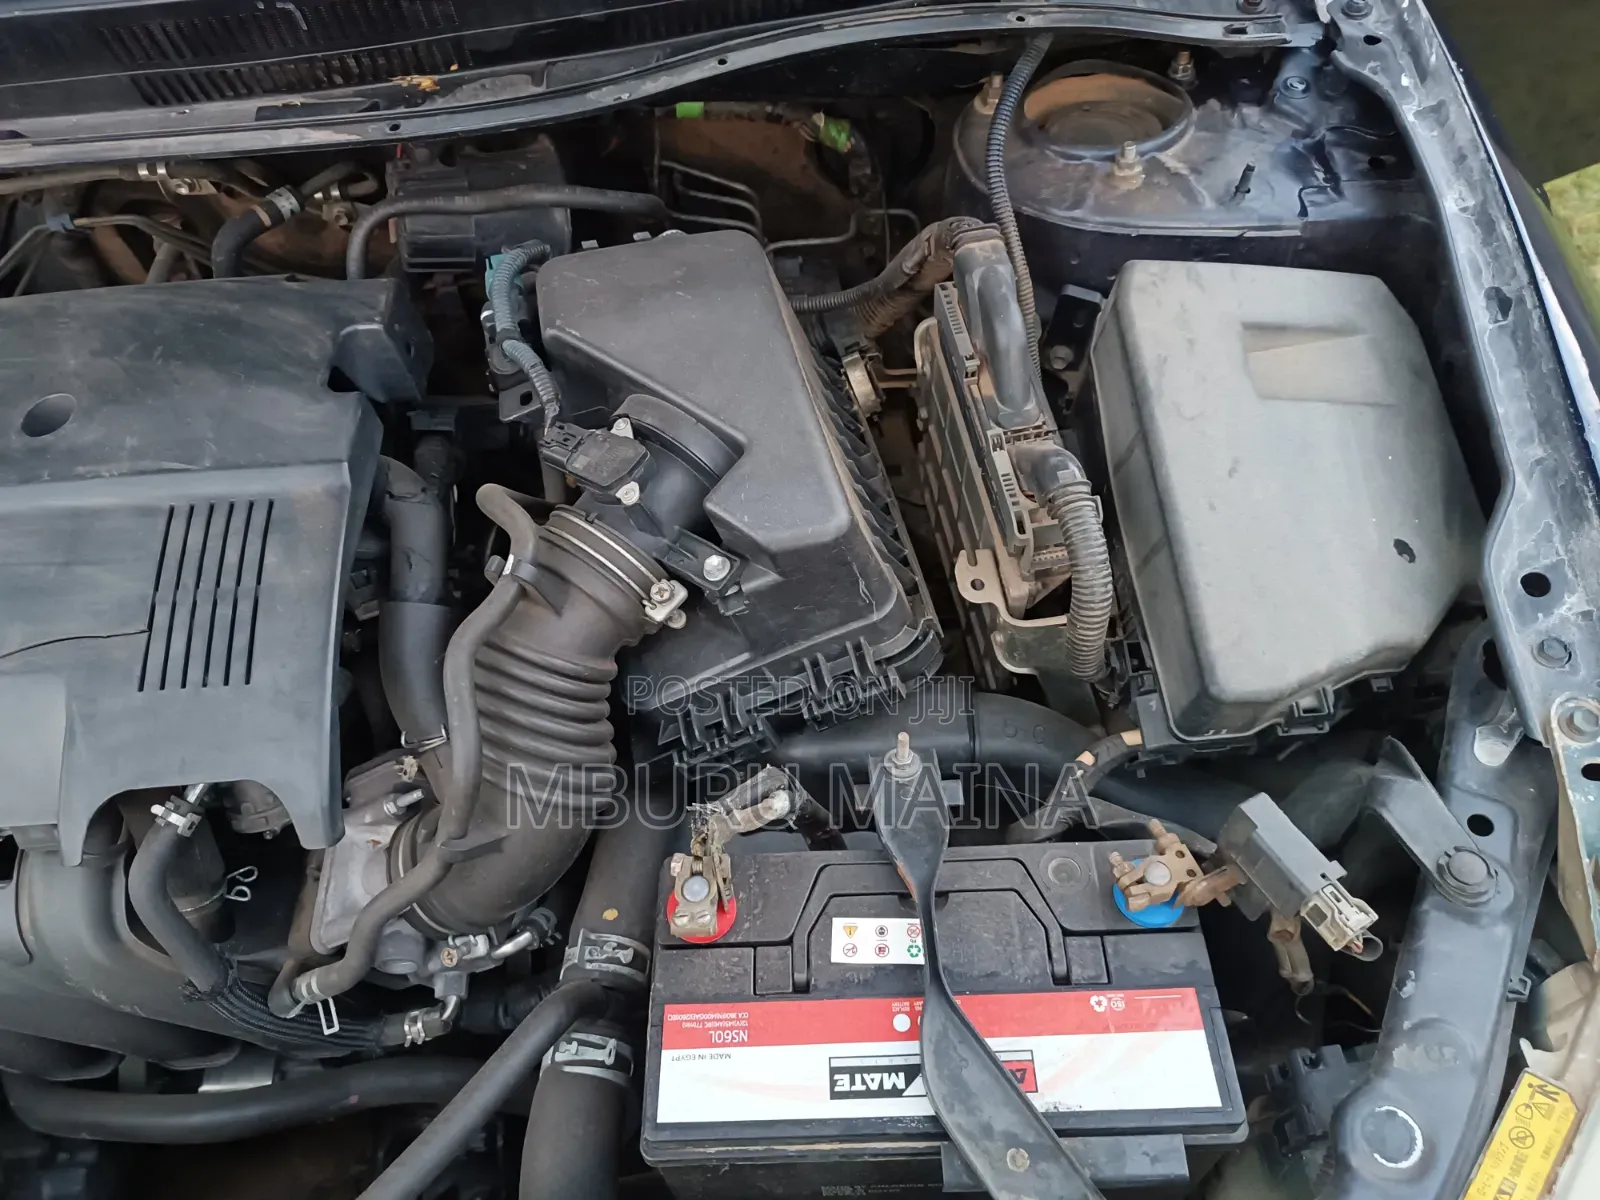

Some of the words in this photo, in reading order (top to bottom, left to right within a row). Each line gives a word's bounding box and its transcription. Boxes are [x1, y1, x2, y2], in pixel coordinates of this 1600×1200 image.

[708, 1029, 748, 1043] NS60L
[671, 1053, 696, 1062] EGYPT
[697, 1053, 707, 1061] IN
[708, 1052, 731, 1060] MADE
[833, 1071, 906, 1092] MATE
